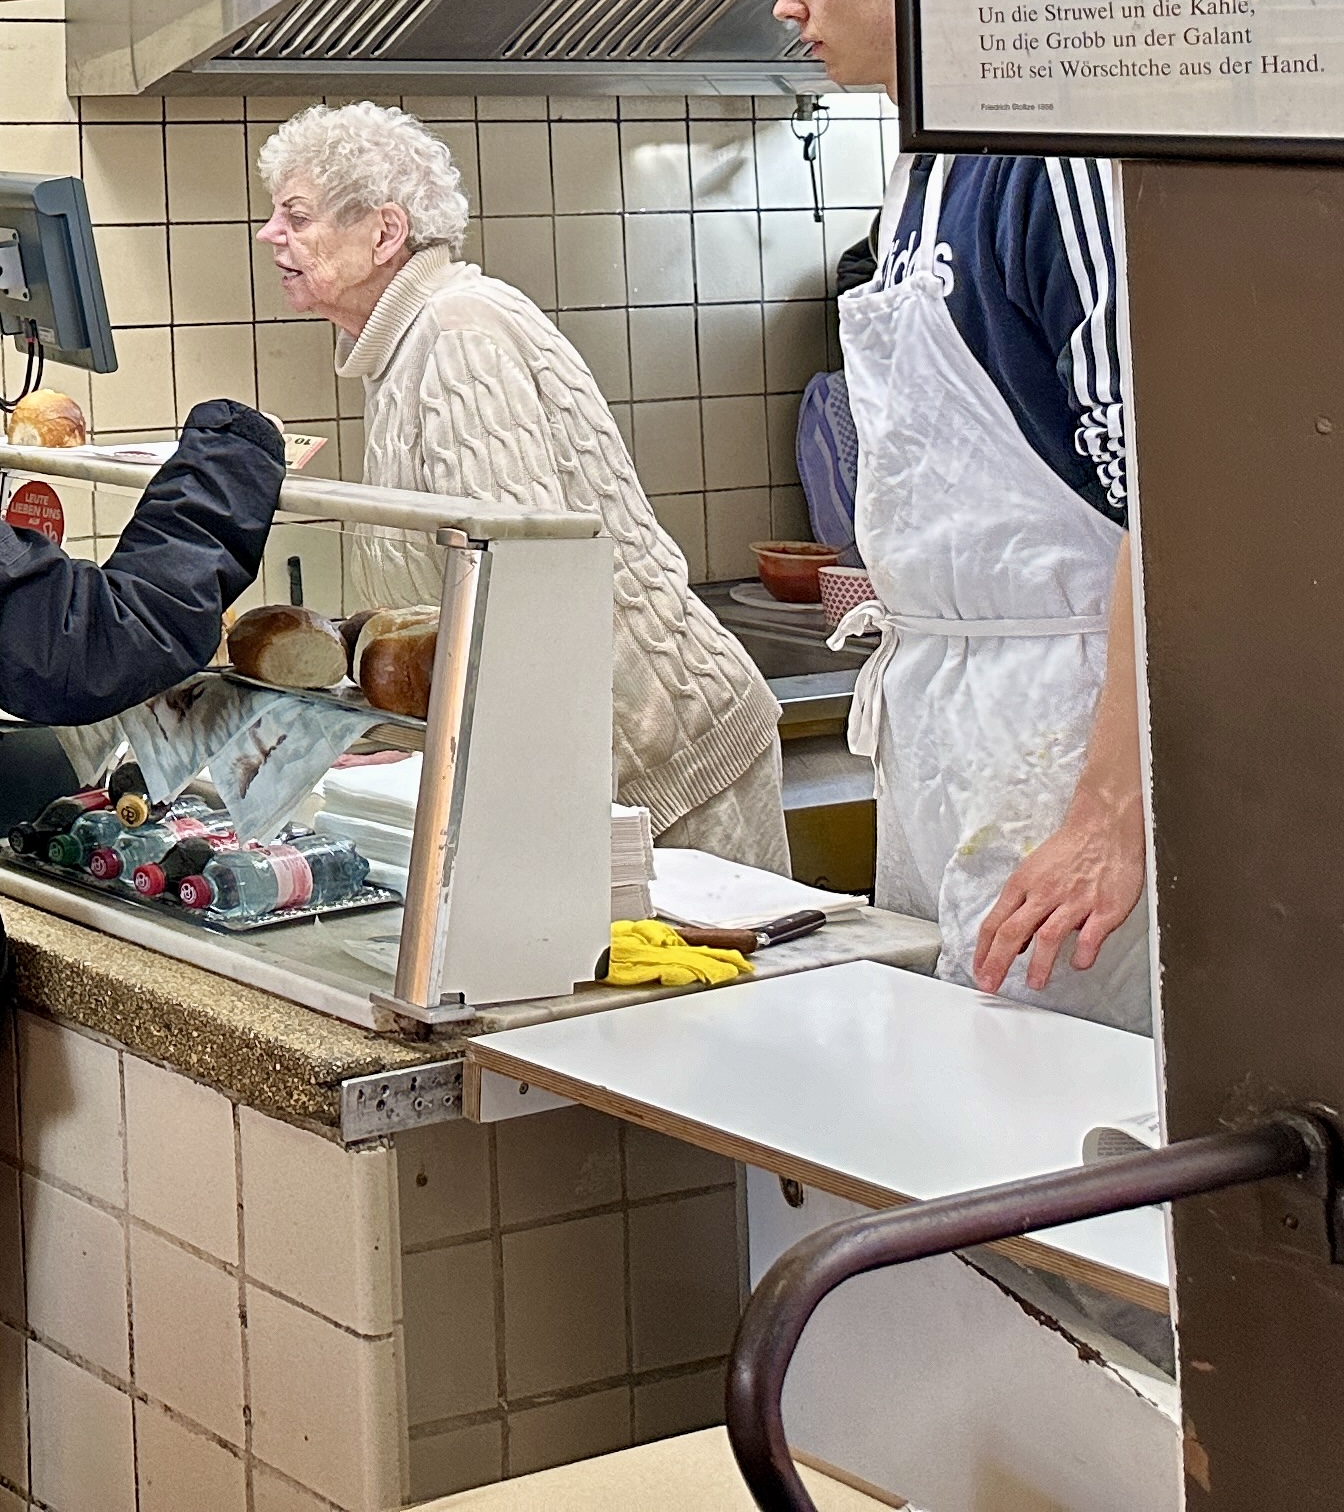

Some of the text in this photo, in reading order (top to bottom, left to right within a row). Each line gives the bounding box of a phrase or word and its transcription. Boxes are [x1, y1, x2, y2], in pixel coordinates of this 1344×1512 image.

[25, 492, 49, 506] LEUTE
[11, 500, 61, 521] LIEBEN UNS
